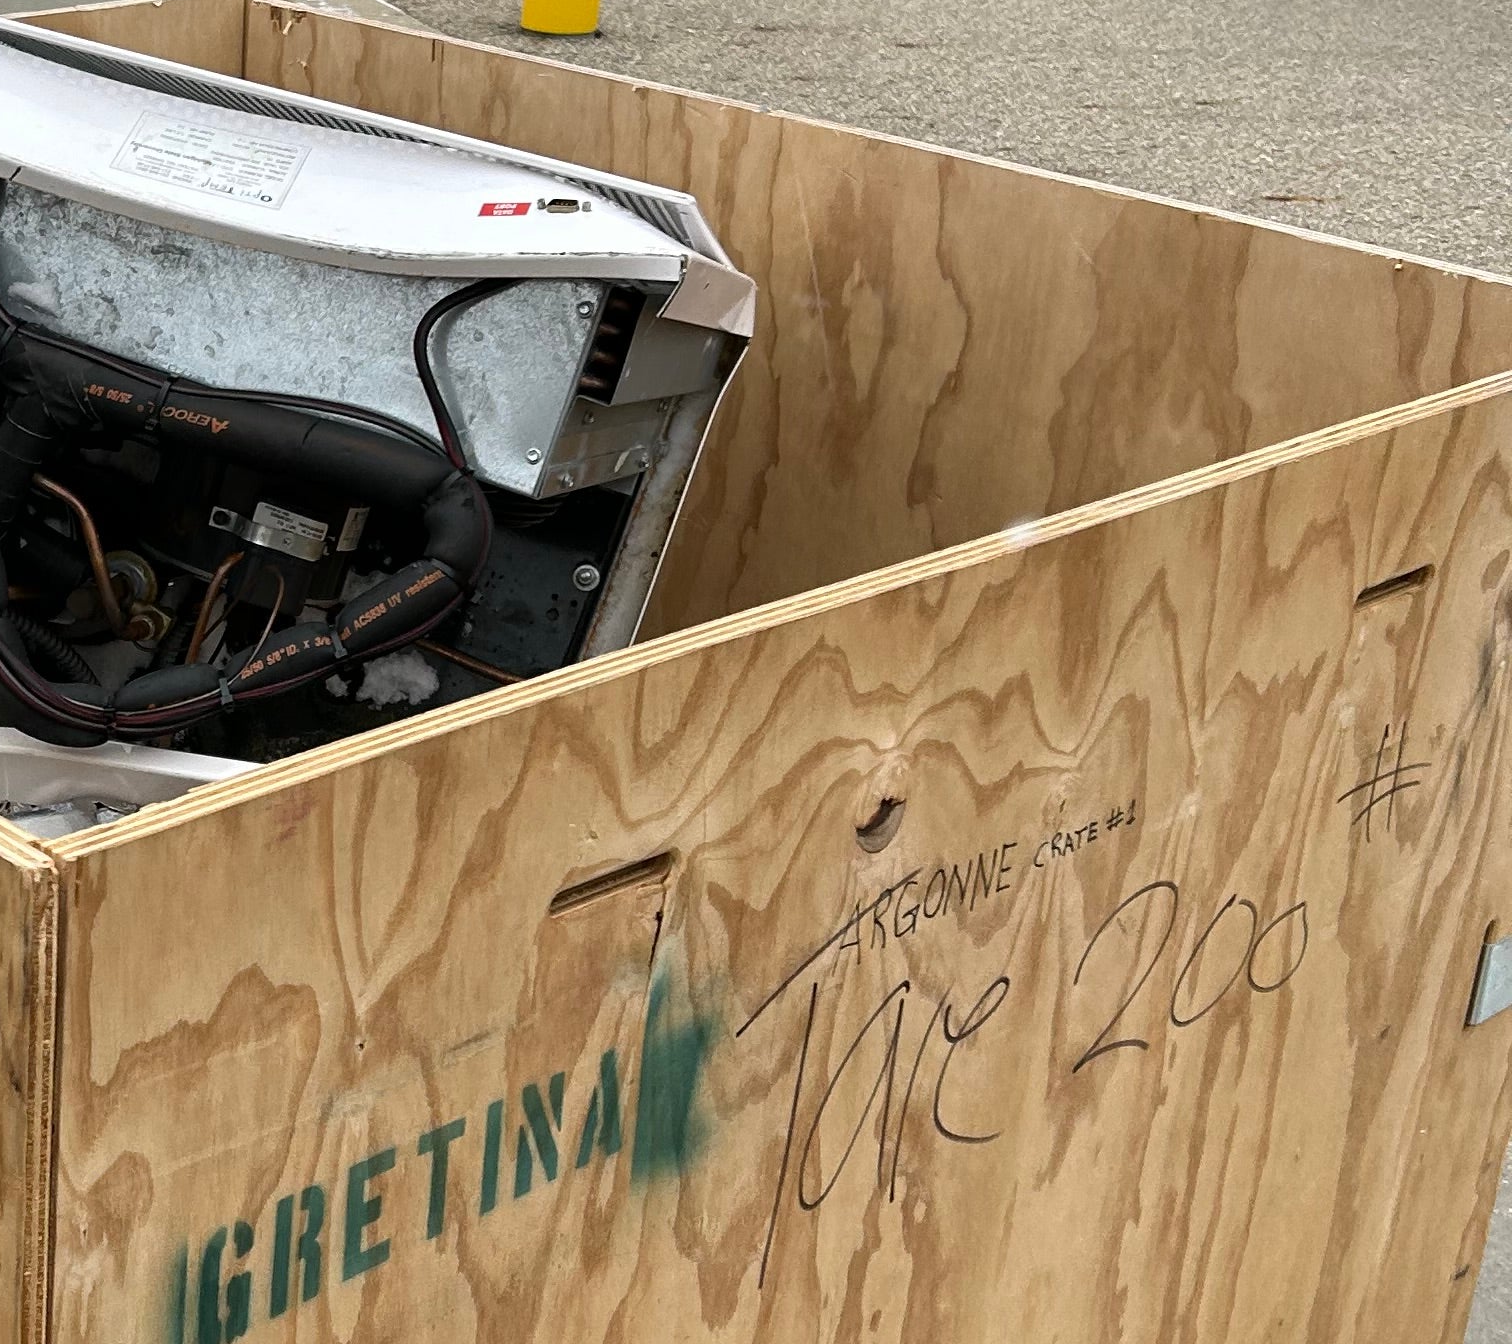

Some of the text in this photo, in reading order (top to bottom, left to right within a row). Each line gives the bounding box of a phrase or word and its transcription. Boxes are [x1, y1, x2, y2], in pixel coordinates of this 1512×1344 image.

[148, 401, 230, 434] AEROCL
[387, 592, 402, 608] UV
[838, 841, 1018, 968] ARGONNE
[1034, 820, 1100, 870] CRATE
[1073, 880, 1310, 1074] 200
